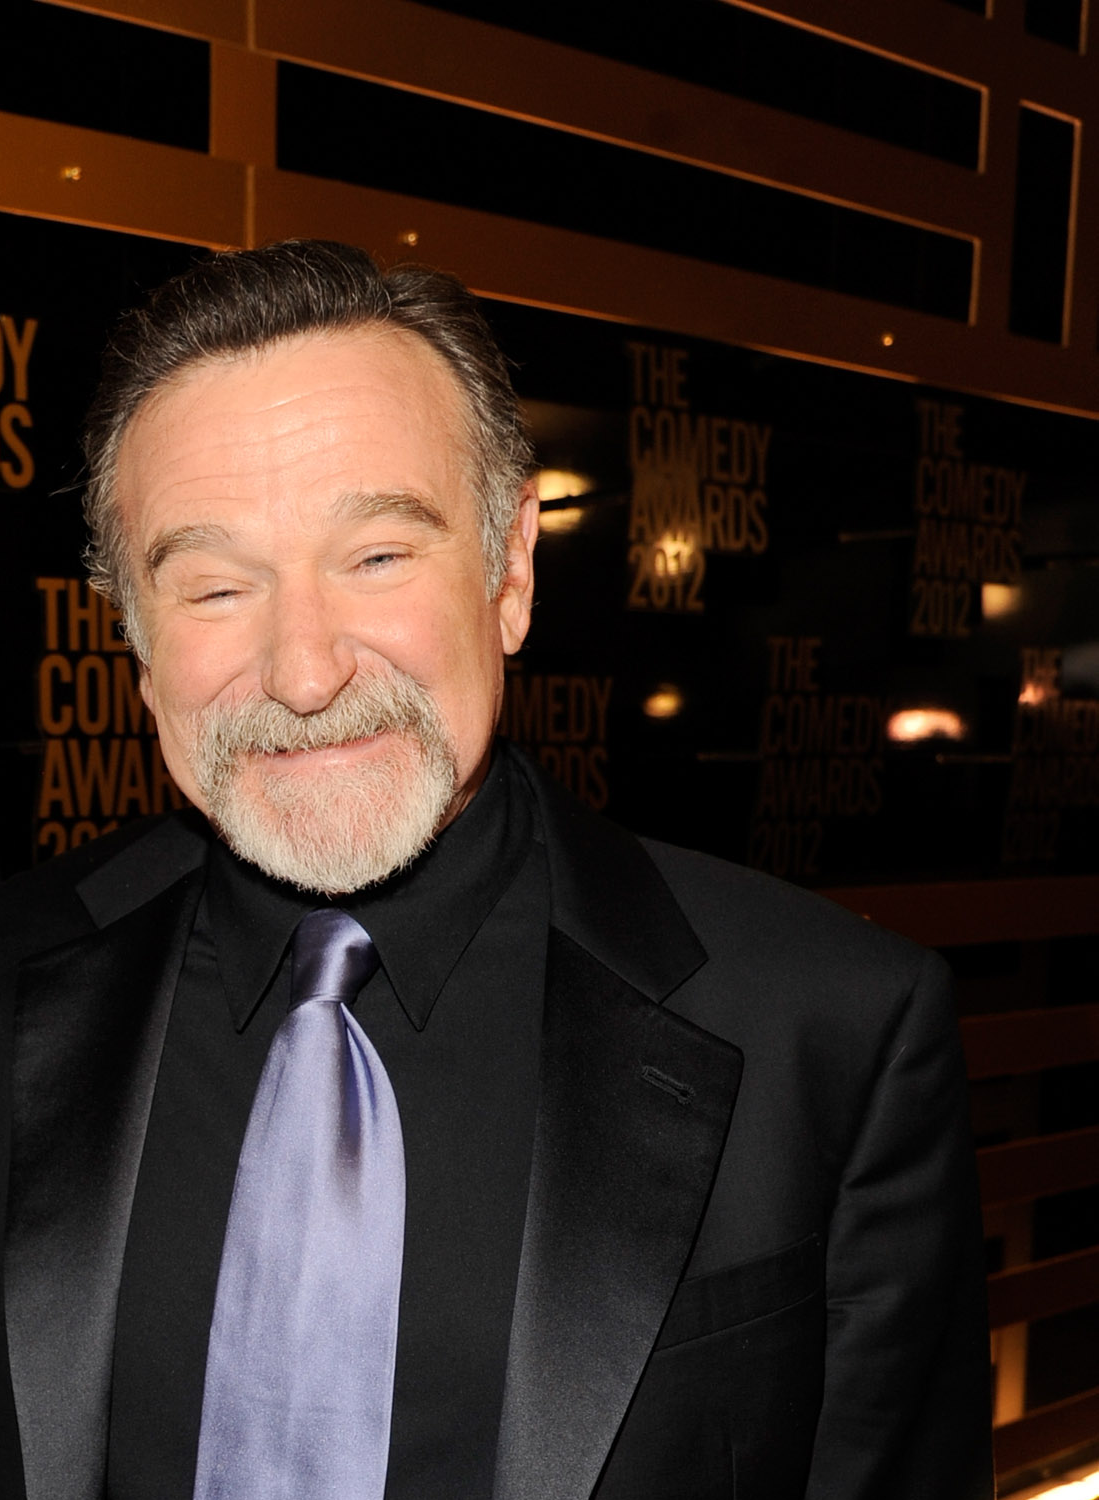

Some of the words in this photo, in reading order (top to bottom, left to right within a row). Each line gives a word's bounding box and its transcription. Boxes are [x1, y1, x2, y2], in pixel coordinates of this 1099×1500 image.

[626, 341, 690, 408] THE
[627, 405, 772, 485] COMEDY
[913, 396, 966, 458] THE
[627, 472, 768, 555] AWARDS
[914, 455, 1028, 525] COMEDY
[627, 545, 706, 611] 2012
[913, 517, 1023, 586] AWARDS
[908, 579, 972, 638] 2012
[37, 653, 157, 737] COM
[766, 634, 822, 692] THE
